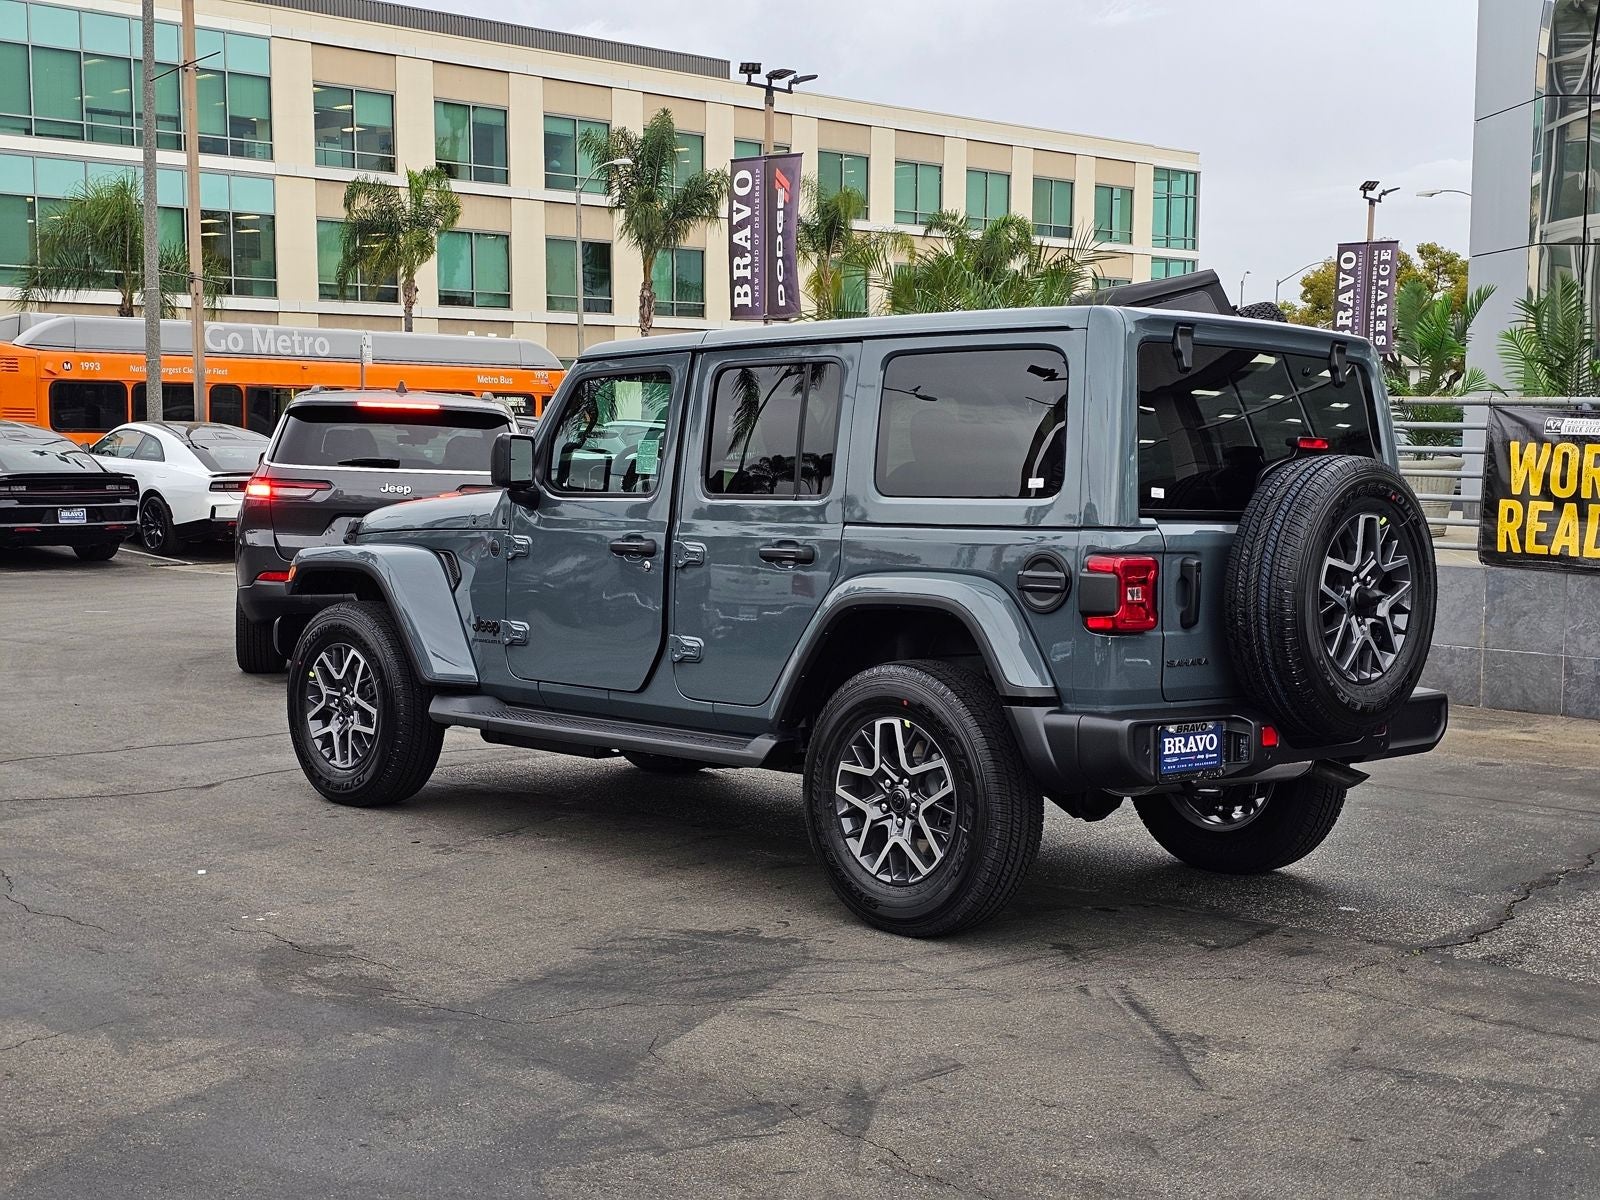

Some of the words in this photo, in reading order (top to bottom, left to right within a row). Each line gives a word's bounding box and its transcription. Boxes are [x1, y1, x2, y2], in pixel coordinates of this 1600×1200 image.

[732, 169, 753, 308] BRAVO
[754, 233, 760, 245] OF
[776, 187, 786, 307] DODGE
[1375, 249, 1392, 346] SERVICE
[204, 324, 244, 353] Go
[251, 326, 330, 357] Metro
[80, 361, 101, 372] 1993
[161, 366, 181, 375] argest
[212, 367, 228, 375] Fleet
[477, 375, 499, 384] Metro
[500, 375, 513, 385] Bus
[534, 371, 549, 379] 1993
[380, 482, 412, 496] Jeep
[472, 614, 500, 637] Jeep
[1176, 722, 1208, 733] BRAVO
[1163, 733, 1218, 755] BRAVO
